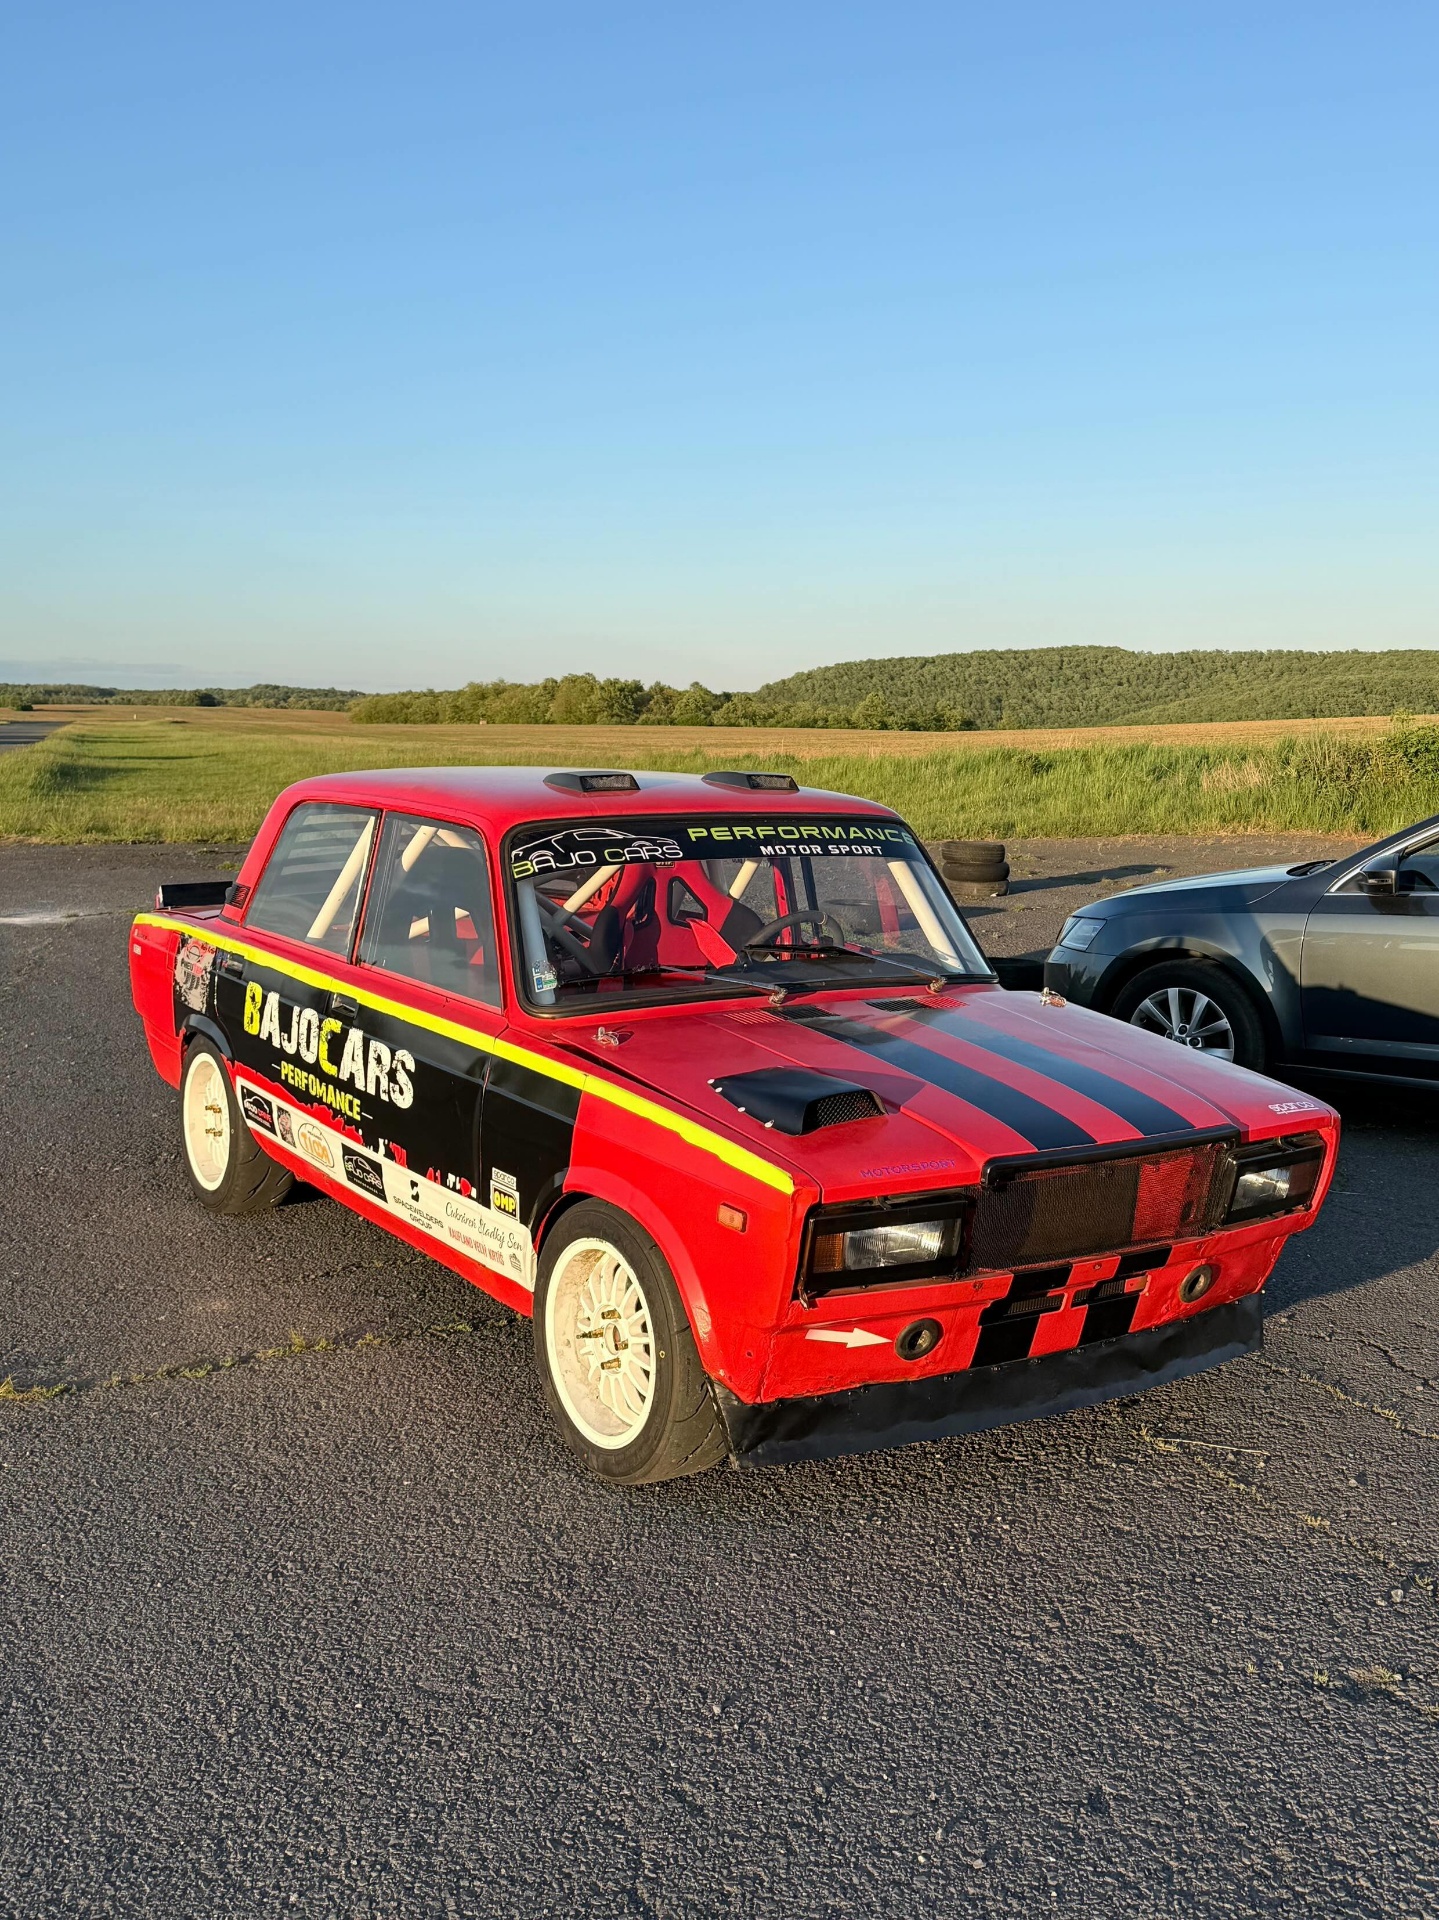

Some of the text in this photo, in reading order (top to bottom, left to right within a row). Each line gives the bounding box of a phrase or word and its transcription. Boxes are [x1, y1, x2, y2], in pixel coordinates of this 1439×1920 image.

[687, 826, 916, 846] PERFORMANCE
[759, 844, 883, 856] MOTOR SPORT
[511, 845, 684, 879] BAJO CARS
[243, 981, 416, 1109] BAJOCARS
[281, 1060, 361, 1121] PERFOMANCE
[493, 1169, 515, 1185] sparco
[860, 1159, 956, 1178] MOTORSPORT
[493, 1190, 516, 1213] OMP
[506, 1232, 523, 1252] Sen
